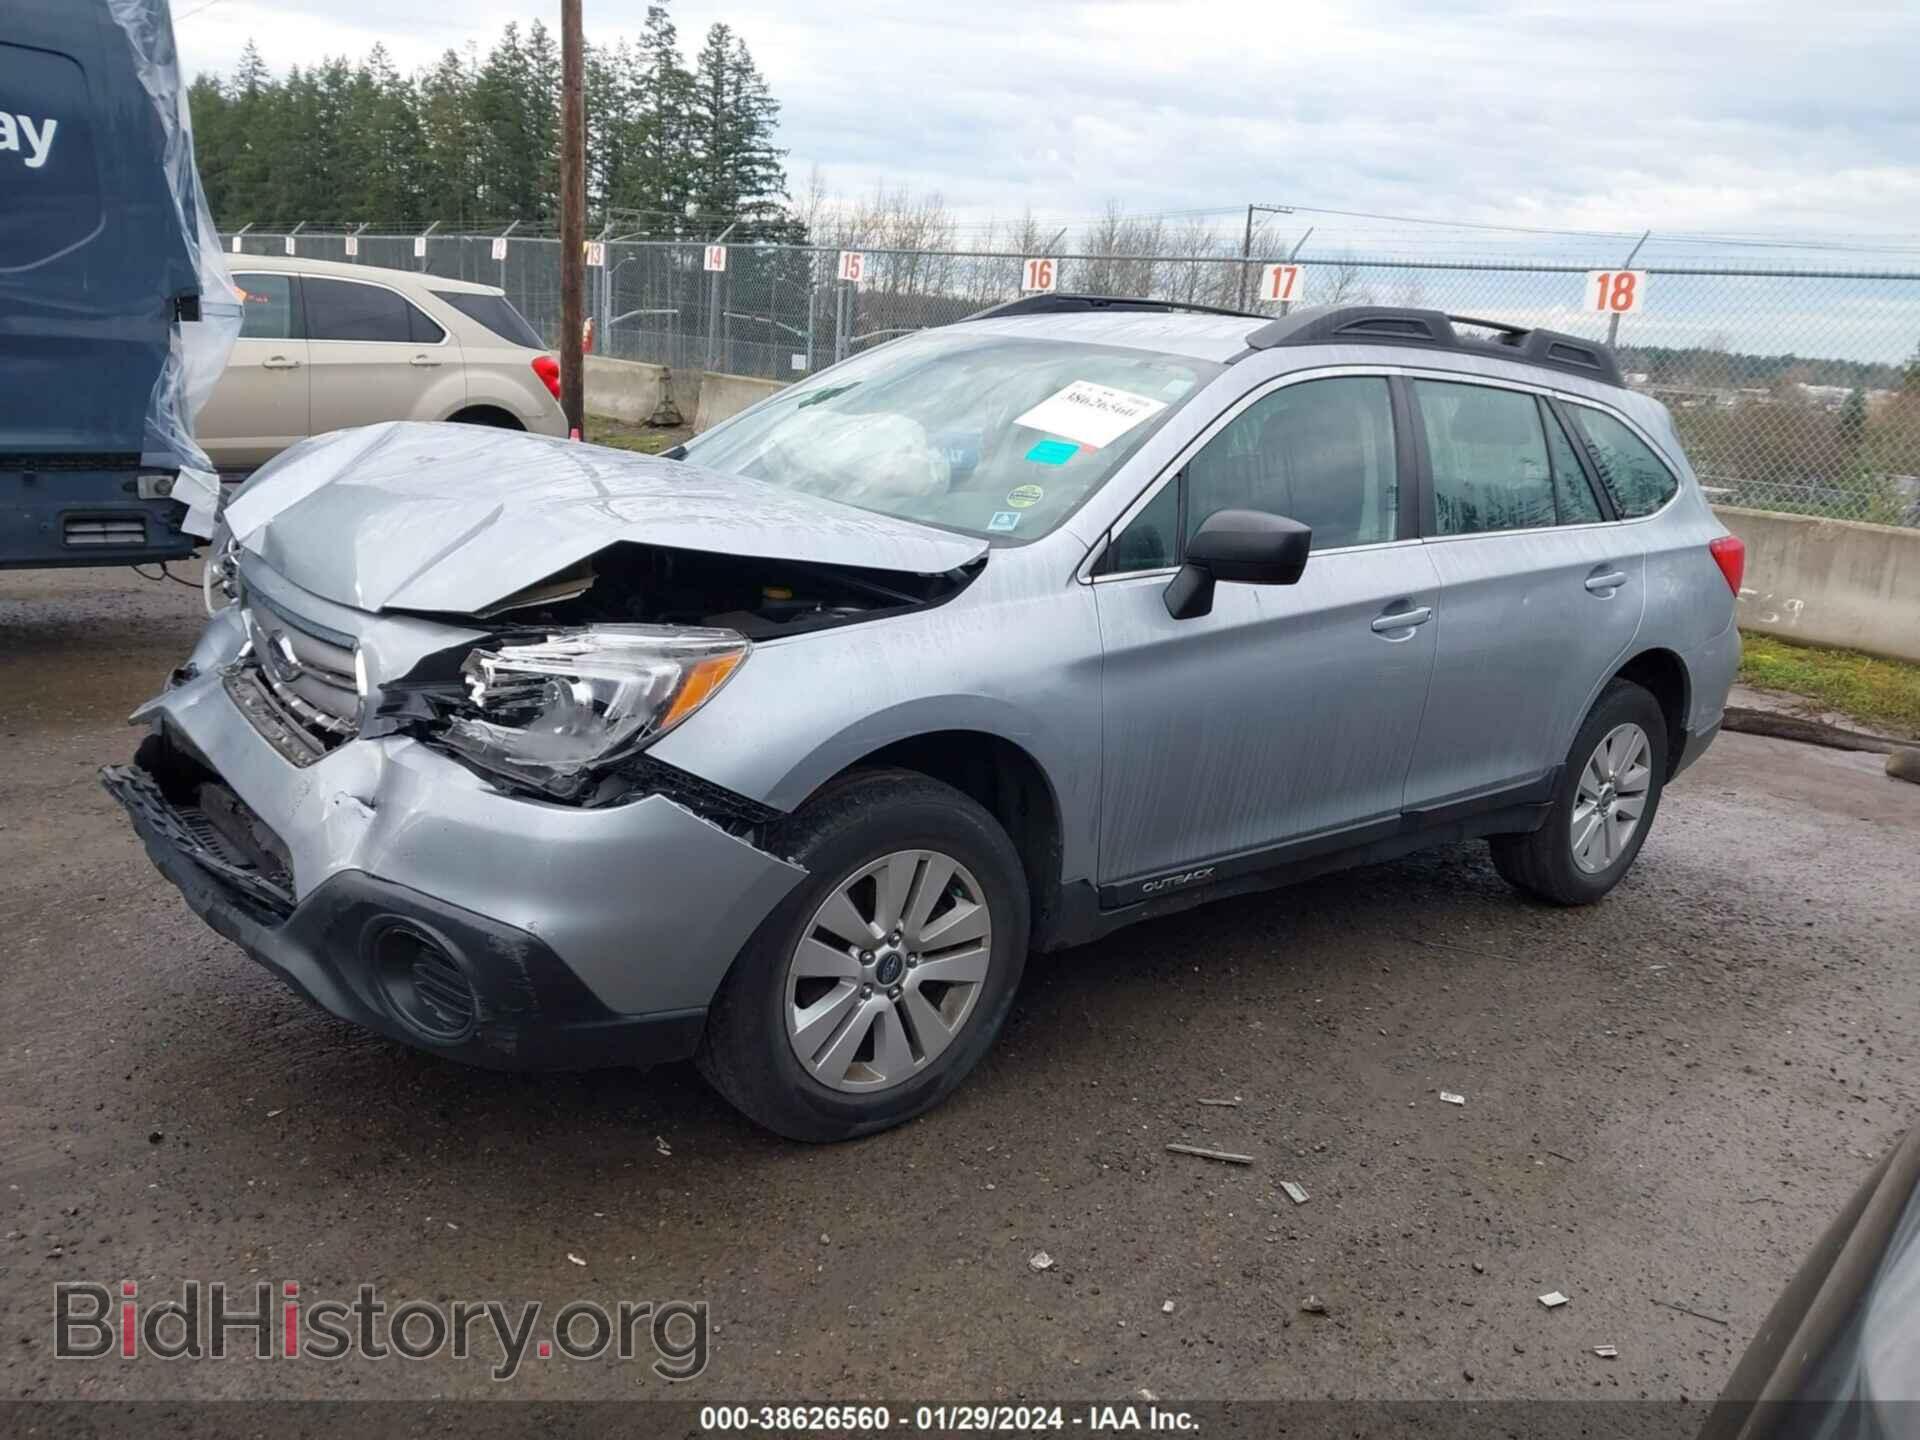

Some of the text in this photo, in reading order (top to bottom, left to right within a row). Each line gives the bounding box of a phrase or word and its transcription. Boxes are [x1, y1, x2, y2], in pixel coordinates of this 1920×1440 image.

[0, 111, 58, 168] ay
[588, 245, 601, 265] 13
[707, 247, 722, 269] 14
[842, 253, 860, 279] 15
[1028, 260, 1052, 289] 16
[1271, 266, 1297, 298] 17
[1597, 271, 1637, 311] 18
